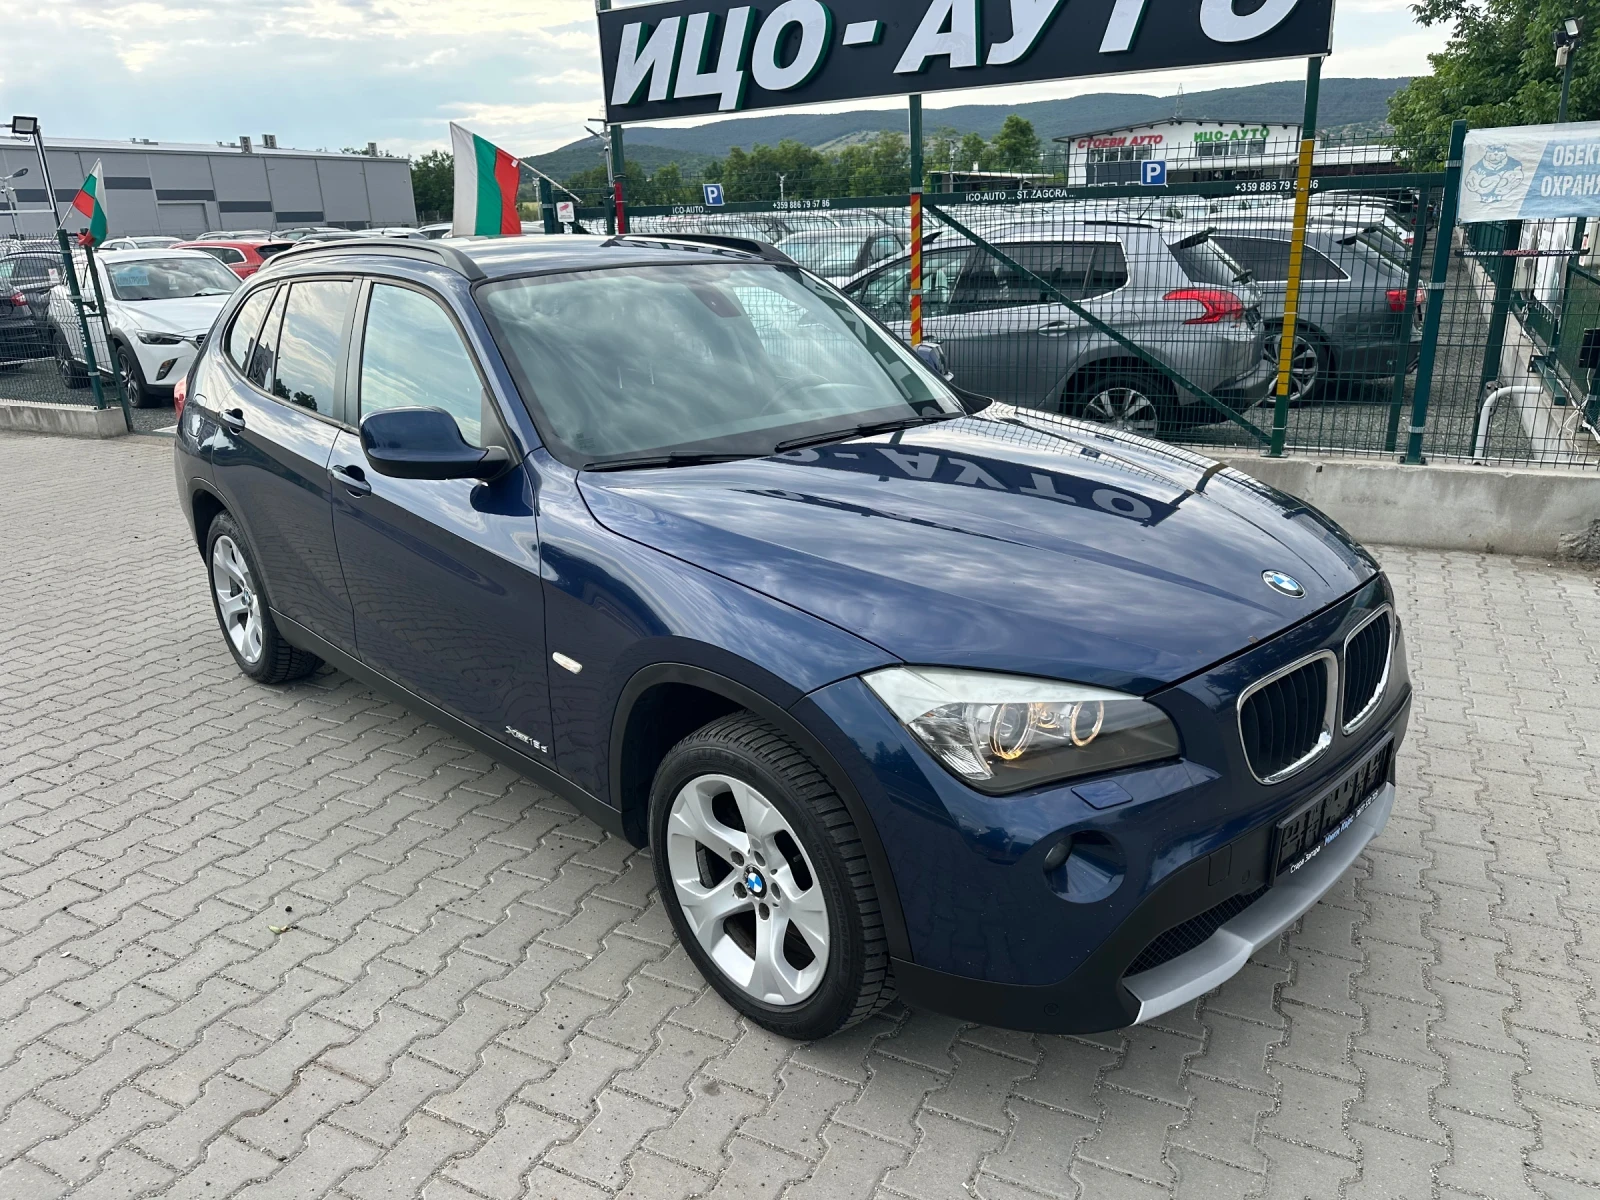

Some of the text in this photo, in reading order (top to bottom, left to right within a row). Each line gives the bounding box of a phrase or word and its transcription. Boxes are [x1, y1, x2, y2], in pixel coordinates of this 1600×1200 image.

[1077, 134, 1163, 149] СТОЕВИ АУТО
[1194, 127, 1270, 143] ИЦО-АУТО
[1146, 163, 1161, 183] P
[1235, 182, 1257, 192] +359
[1259, 181, 1277, 191] 886
[1279, 180, 1291, 190] 79
[707, 186, 718, 204] P
[1030, 189, 1068, 199] ZAGORA
